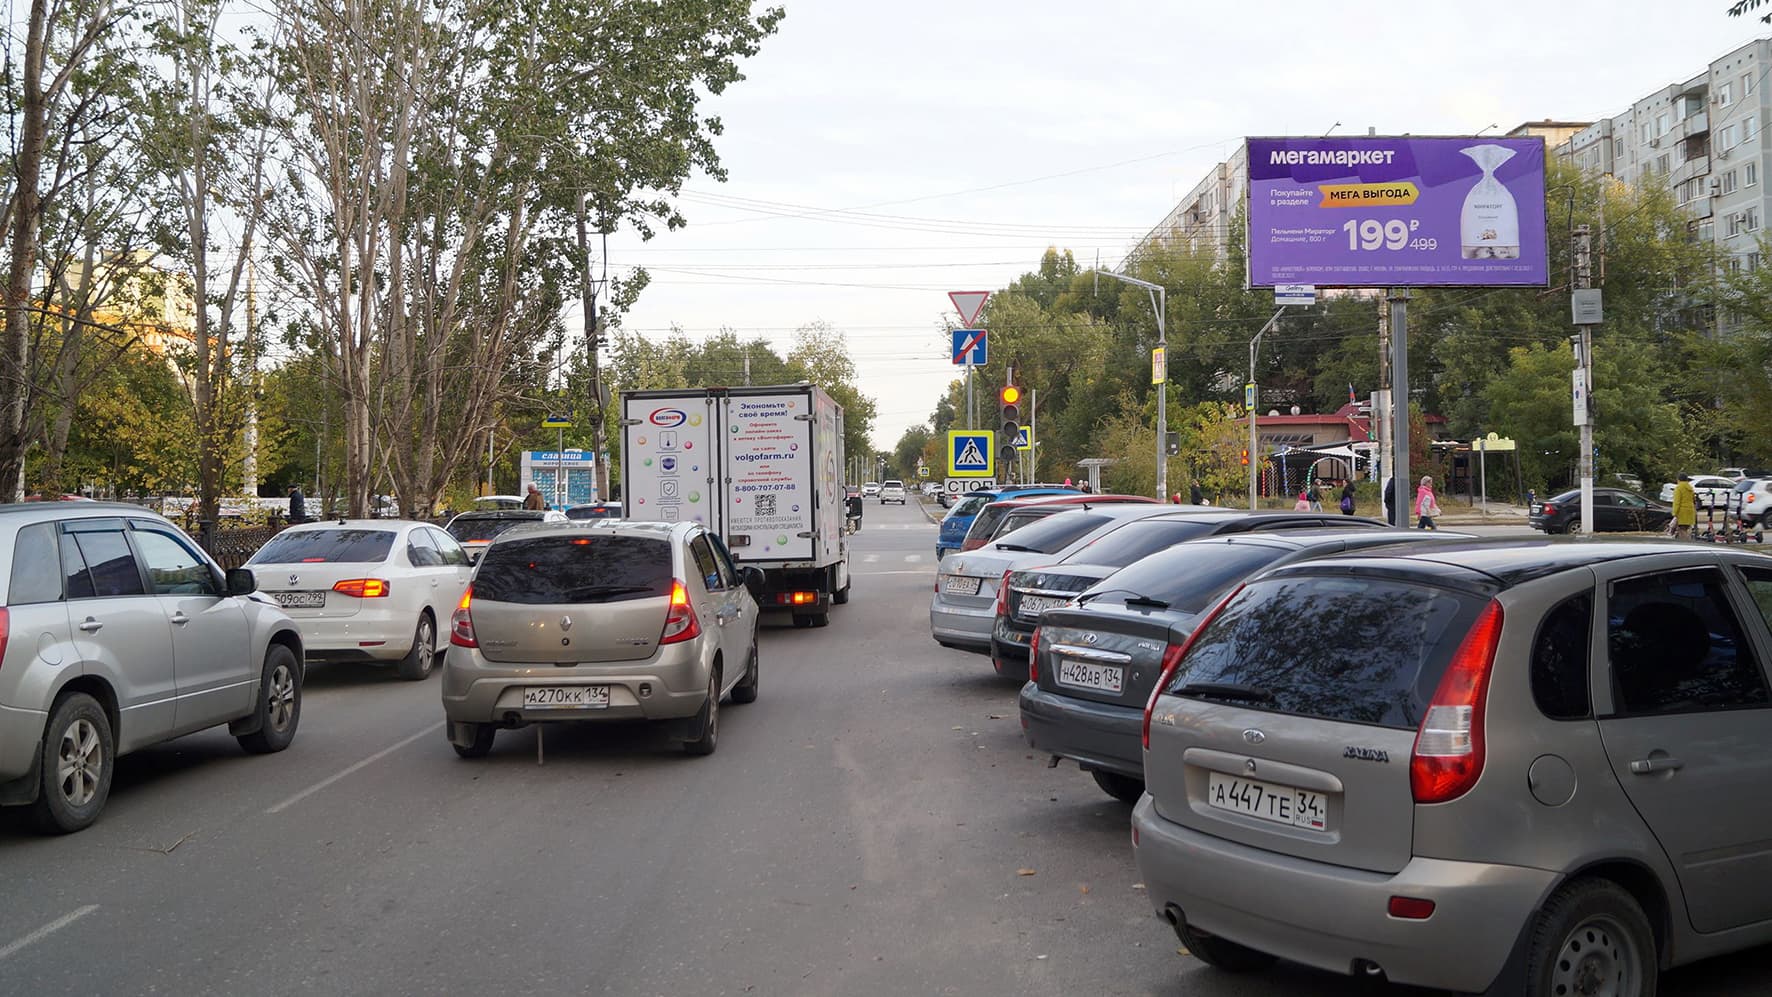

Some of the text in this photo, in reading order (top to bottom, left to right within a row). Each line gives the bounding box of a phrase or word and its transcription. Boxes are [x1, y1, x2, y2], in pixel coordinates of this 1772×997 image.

[1270, 150, 1395, 167] мегамаркет
[1270, 189, 1314, 198] Покупайте
[1330, 188, 1411, 200] МЕГА ВЫГОДА
[1277, 198, 1309, 206] разделе
[1304, 227, 1337, 236] Мираторг
[1409, 238, 1438, 250] 499
[741, 402, 786, 410] Экономьте
[760, 410, 788, 418] время!
[735, 453, 795, 462] volgofarm.ru
[735, 484, 796, 492] 8-800-707-07-88
[948, 480, 993, 493] СТОП
[1103, 668, 1120, 684] 134
[586, 687, 608, 697] 134
[1343, 746, 1389, 763] KALINA
[1297, 792, 1318, 816] 34
[1296, 814, 1311, 825] RUS
